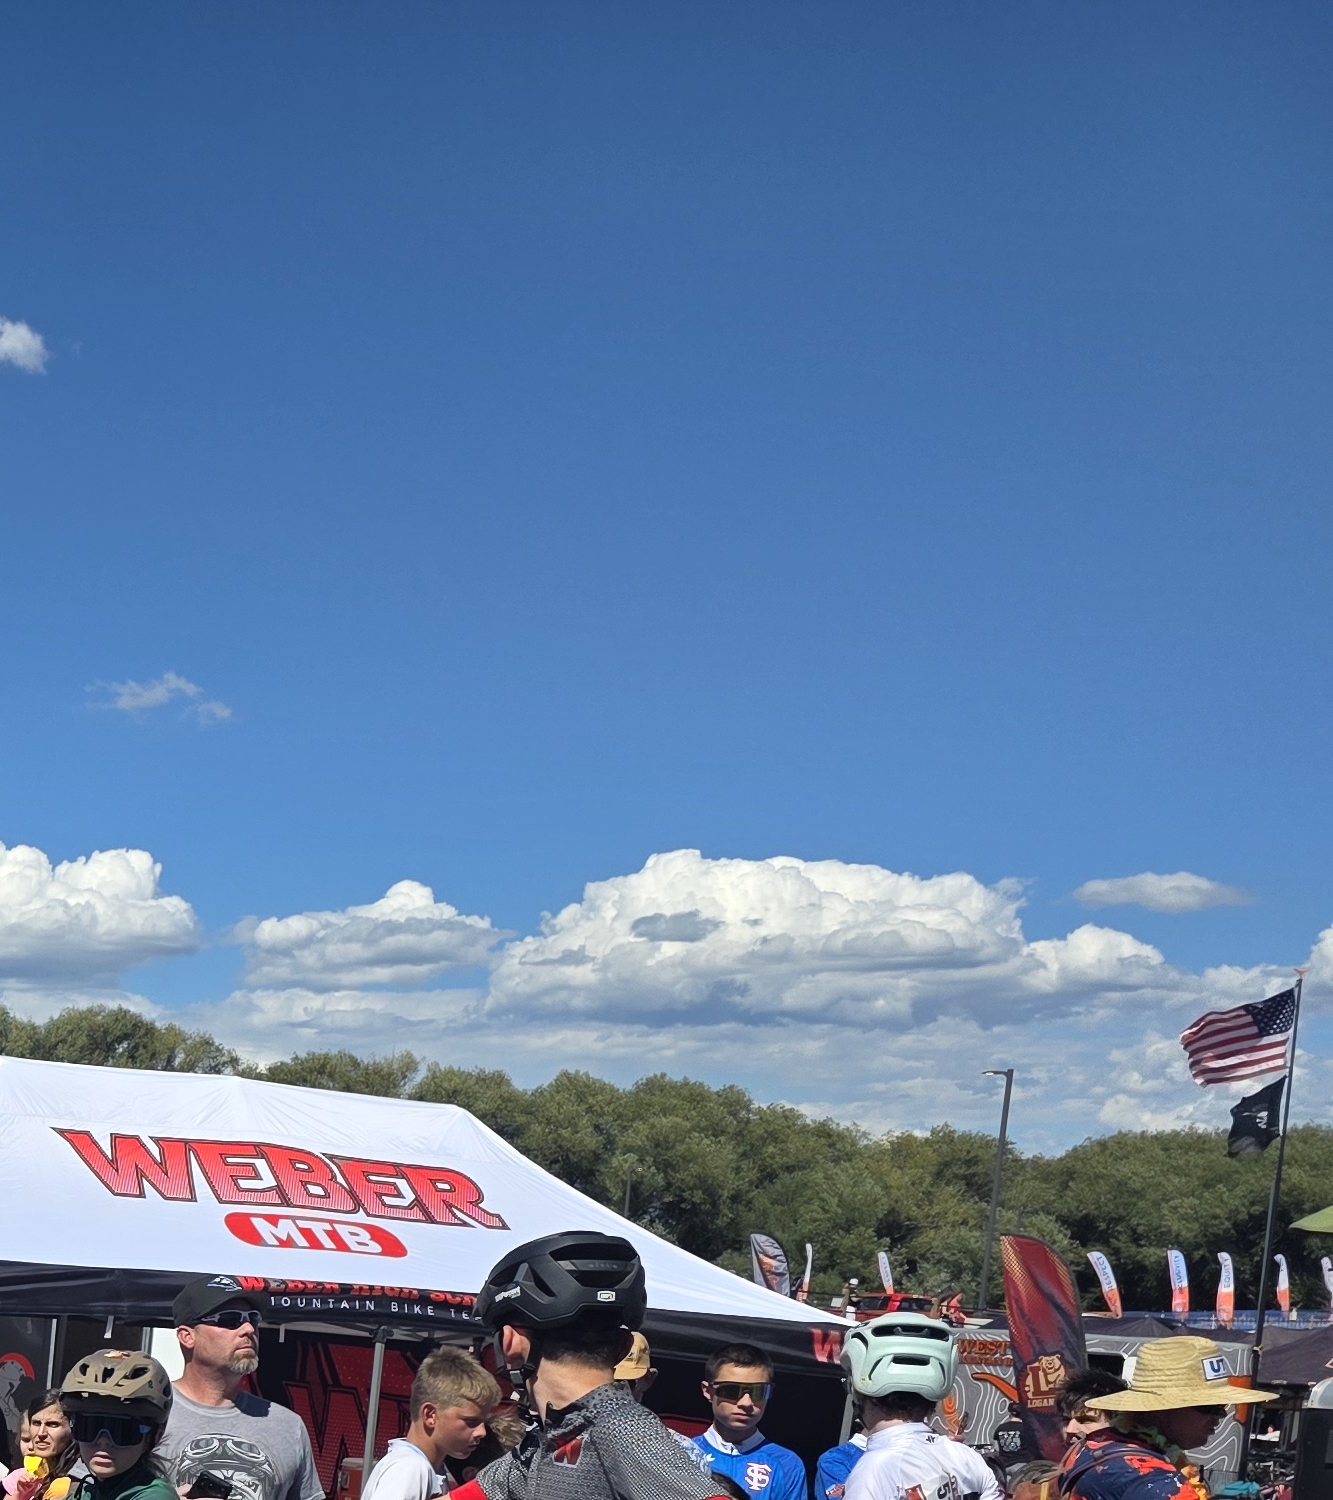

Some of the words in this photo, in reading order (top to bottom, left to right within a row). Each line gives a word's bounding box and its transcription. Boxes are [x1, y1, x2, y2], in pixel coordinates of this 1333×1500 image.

[50, 1127, 512, 1231] WEBER
[257, 1215, 384, 1257] MTB
[391, 1302, 435, 1316] BIKE
[1027, 1398, 1055, 1408] LOGAN
